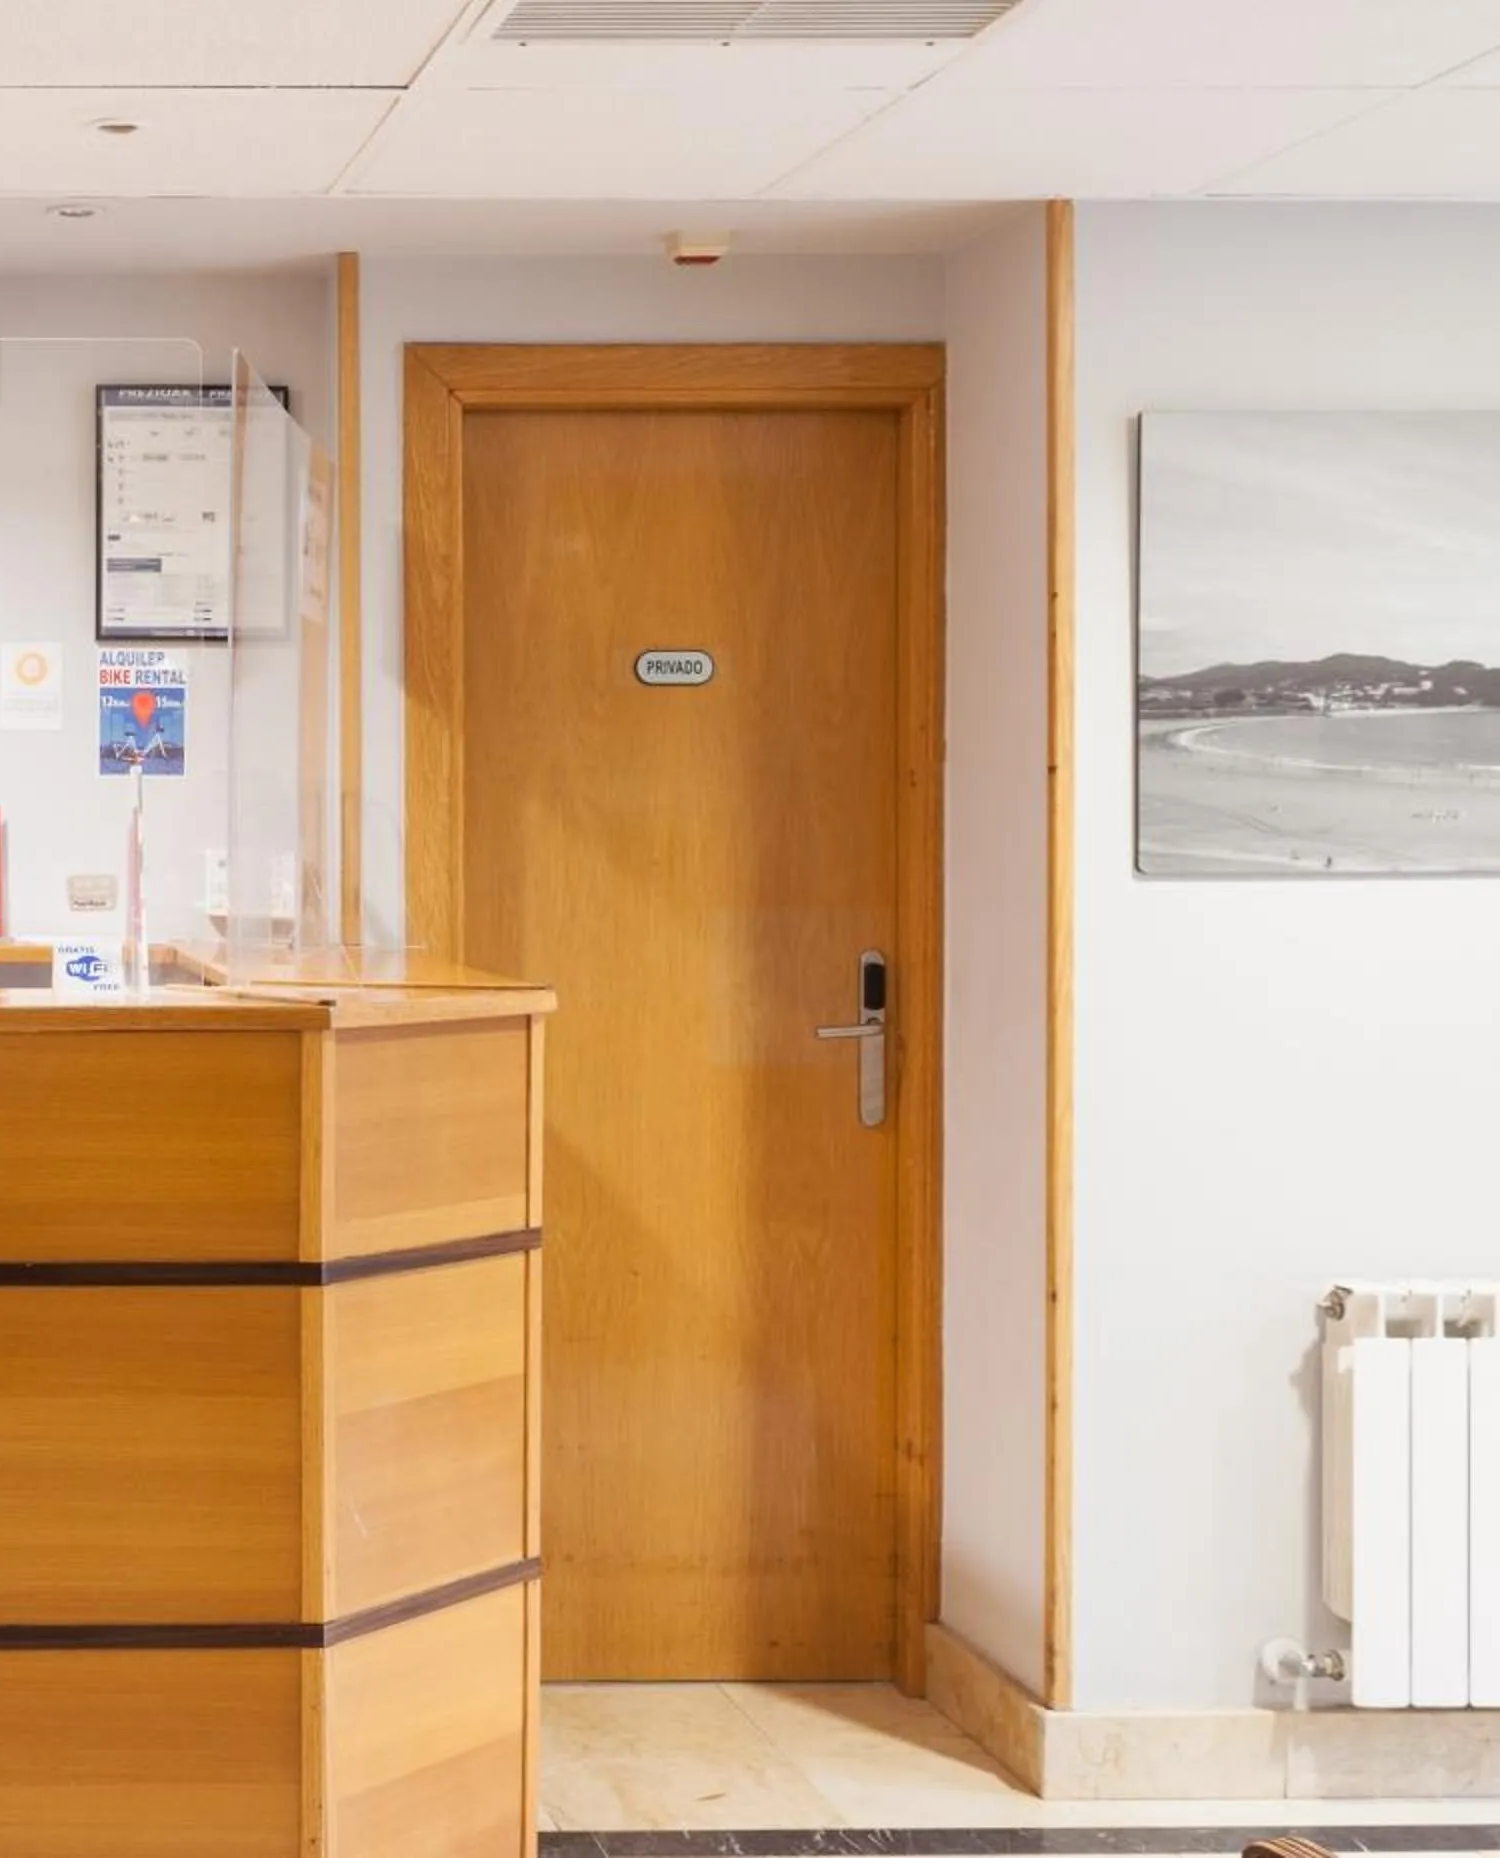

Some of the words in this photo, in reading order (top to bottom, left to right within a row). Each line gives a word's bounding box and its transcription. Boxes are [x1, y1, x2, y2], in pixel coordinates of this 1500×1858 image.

[646, 659, 704, 675] PRIVADO
[100, 669, 131, 685] BIKE
[135, 669, 187, 684] RENTAL
